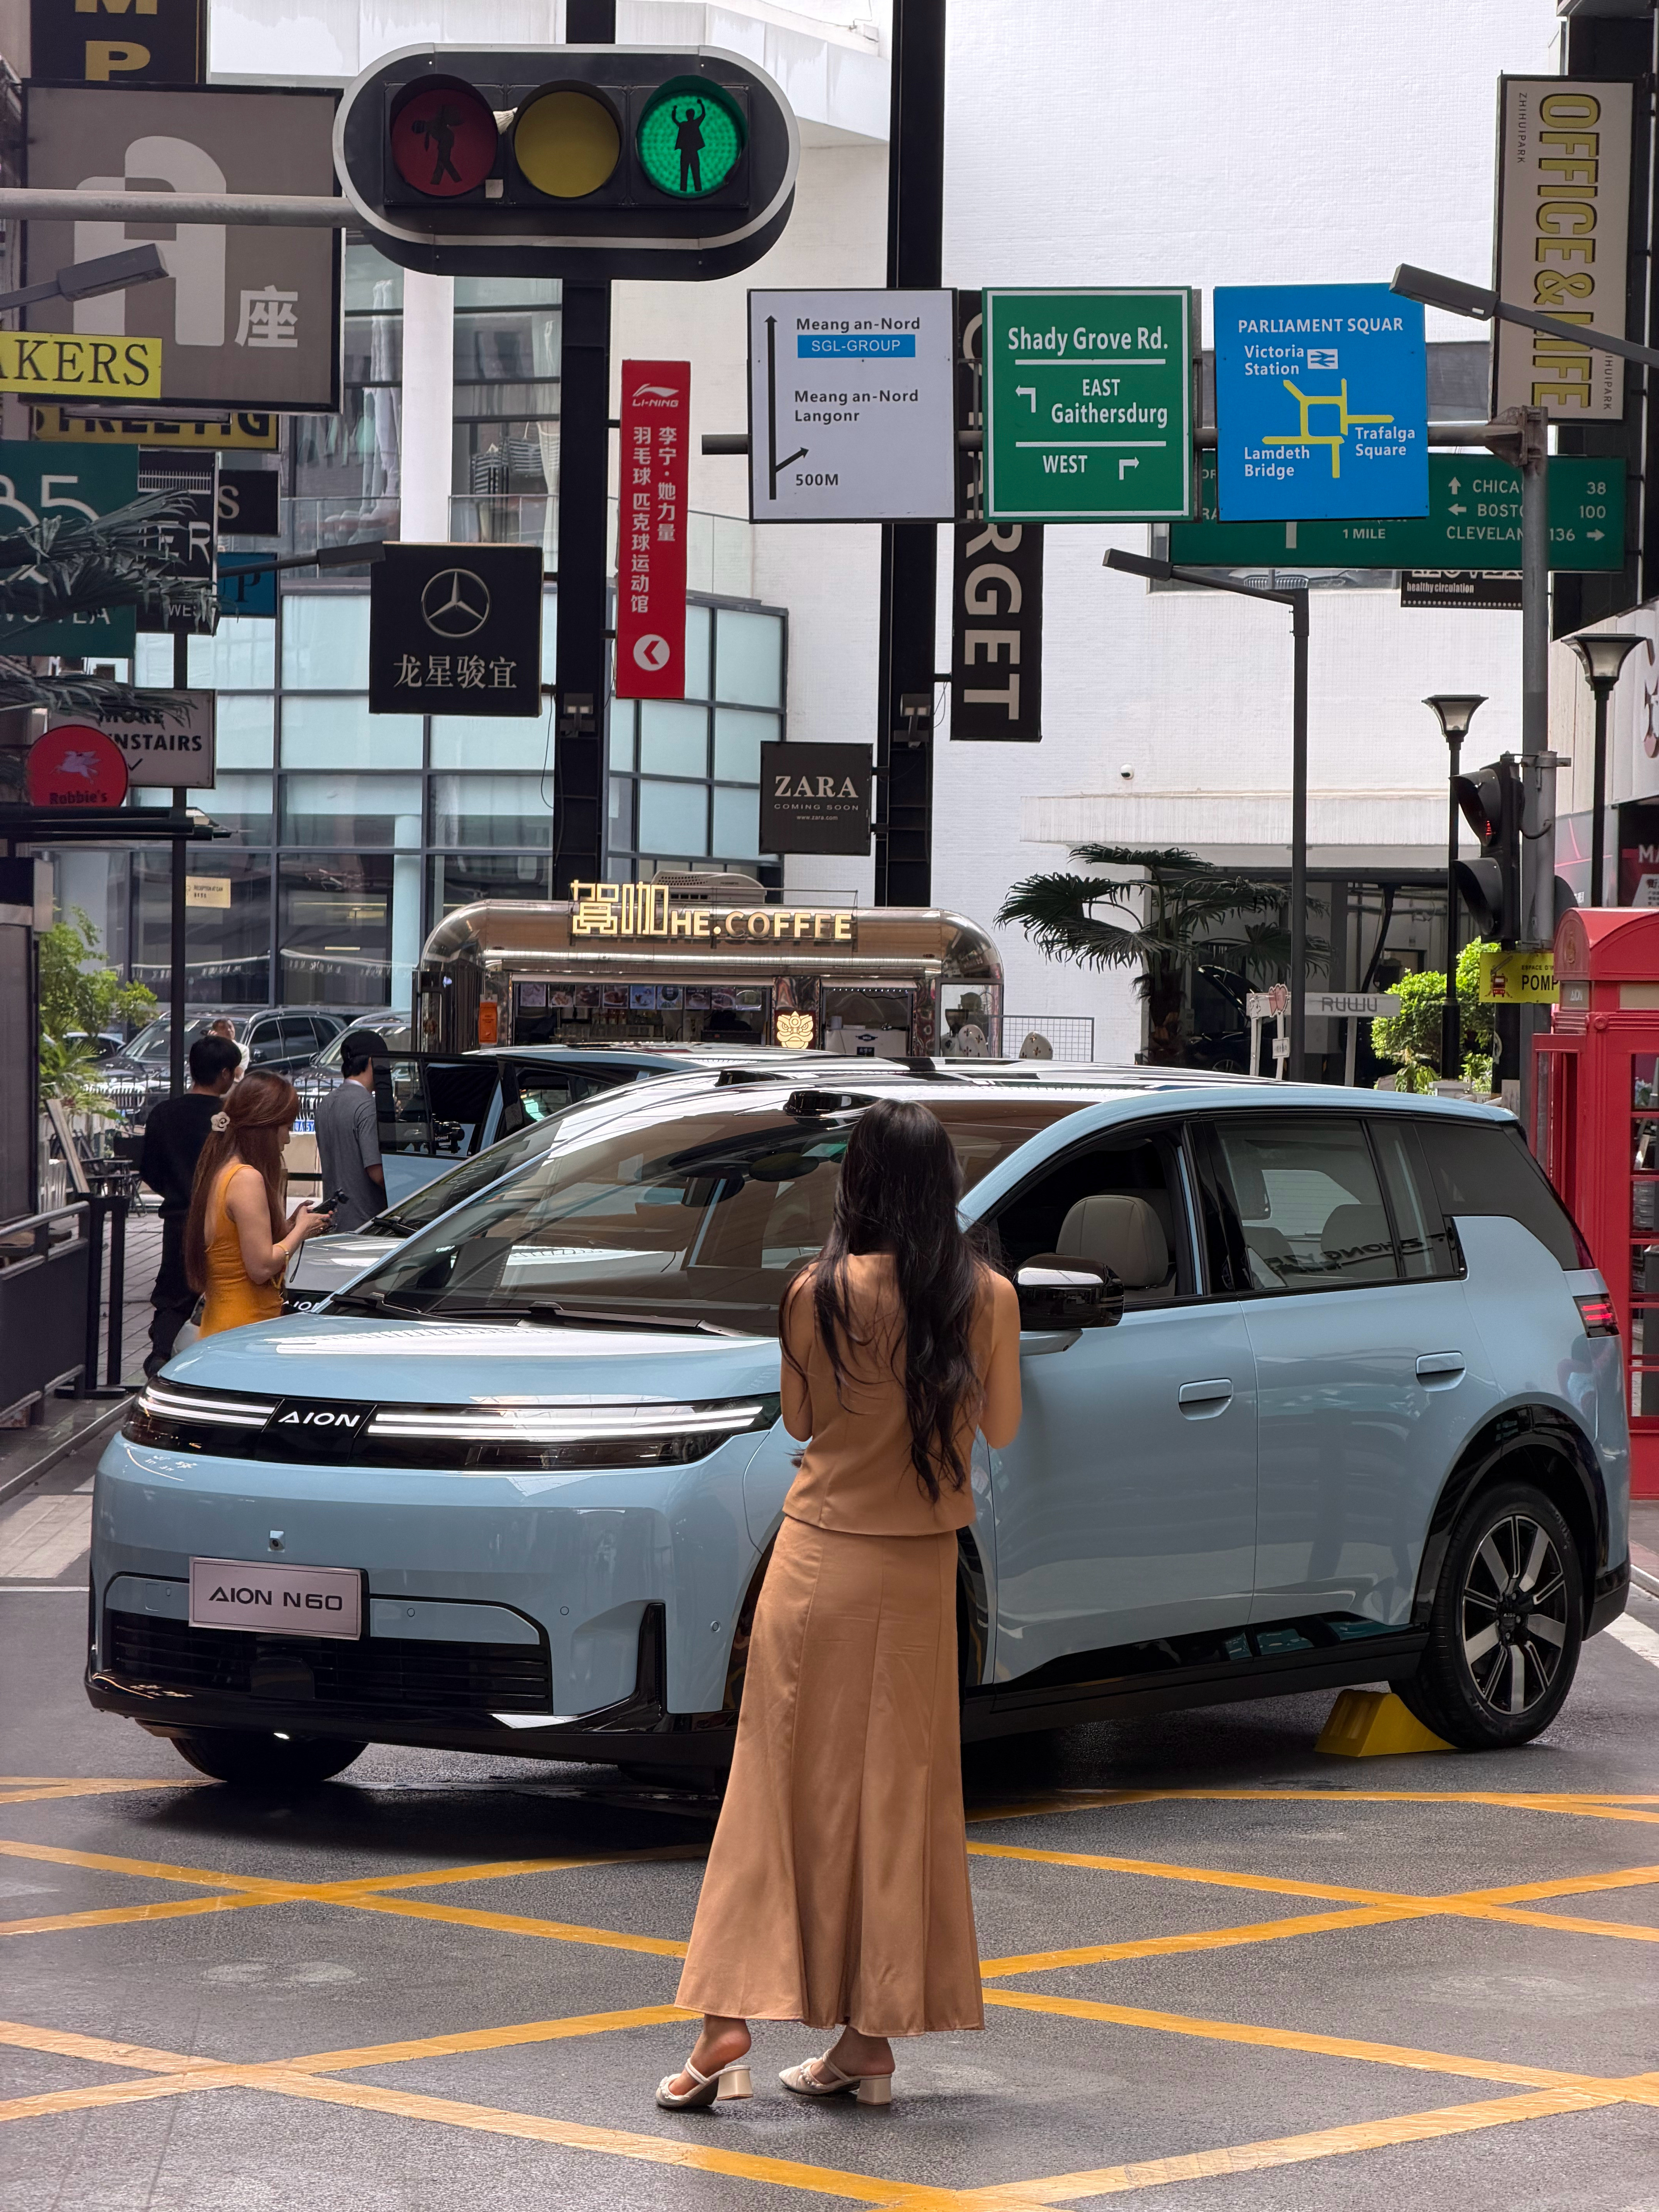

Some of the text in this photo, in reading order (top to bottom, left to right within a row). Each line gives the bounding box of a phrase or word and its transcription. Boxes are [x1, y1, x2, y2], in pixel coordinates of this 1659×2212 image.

[1517, 92, 1528, 163] ZHIHUIPARK
[797, 317, 920, 333] Meang an-Nord
[1238, 317, 1403, 335] PARLIAMENT SQUAR
[811, 340, 901, 352] SGL-GROUP
[1008, 326, 1168, 356] Shady Grove Rd.
[1244, 344, 1304, 358] Victoria
[1245, 362, 1299, 376] Station
[1082, 378, 1120, 396] EAST
[632, 399, 679, 408] LI-NING
[795, 389, 919, 405] Meang an-Nord
[795, 410, 860, 425] Langonr
[1051, 402, 1168, 429] Gaithersdurg
[1355, 426, 1415, 442] Trafalga
[1244, 445, 1310, 460] Lamdeth
[1355, 443, 1407, 459] Square
[1042, 455, 1088, 473] WEST
[1245, 464, 1295, 480] Bridge
[795, 474, 839, 486] 500M
[1473, 479, 1606, 495] CHICA 38
[1580, 505, 1606, 519] 100
[1343, 528, 1386, 539] 1 MILE
[1550, 528, 1576, 541] 136
[1407, 582, 1474, 593] healthy circulation
[393, 653, 517, 689] 龙星骏宜
[774, 776, 859, 798] ZARA
[50, 789, 108, 805] Robbie's
[278, 1411, 361, 1427] AION
[208, 1586, 343, 1611] AION N60
